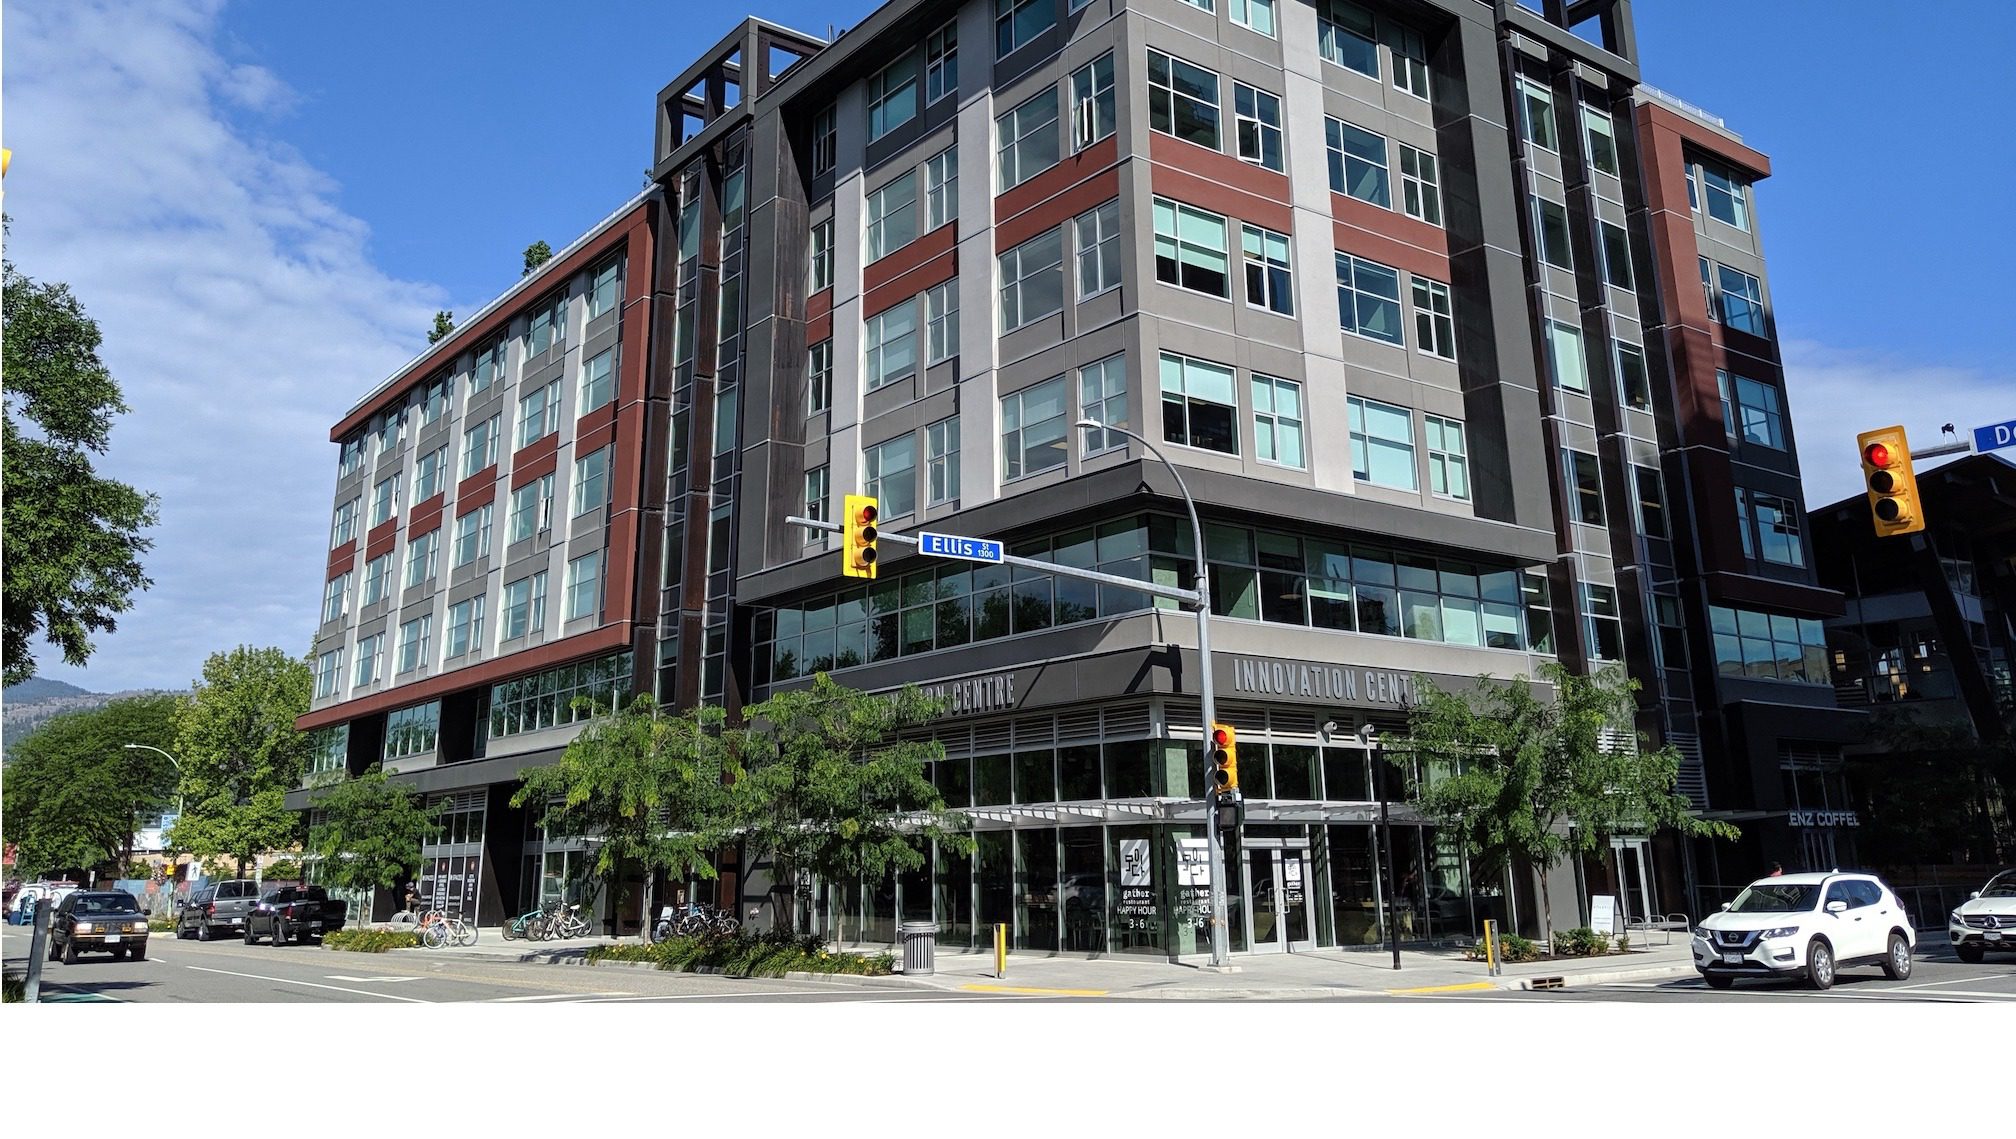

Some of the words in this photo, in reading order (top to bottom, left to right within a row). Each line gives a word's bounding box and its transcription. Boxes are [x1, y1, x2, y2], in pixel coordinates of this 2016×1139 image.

[1994, 425, 2016, 446] D
[932, 537, 973, 556] Ellis
[982, 542, 990, 551] St
[977, 549, 994, 559] 1300
[1233, 659, 1357, 700] INNOVATION
[952, 673, 1015, 712] CENTRE
[1122, 888, 1150, 900] gather
[1116, 905, 1137, 915] HAPPY
[1138, 905, 1157, 916] HOUR
